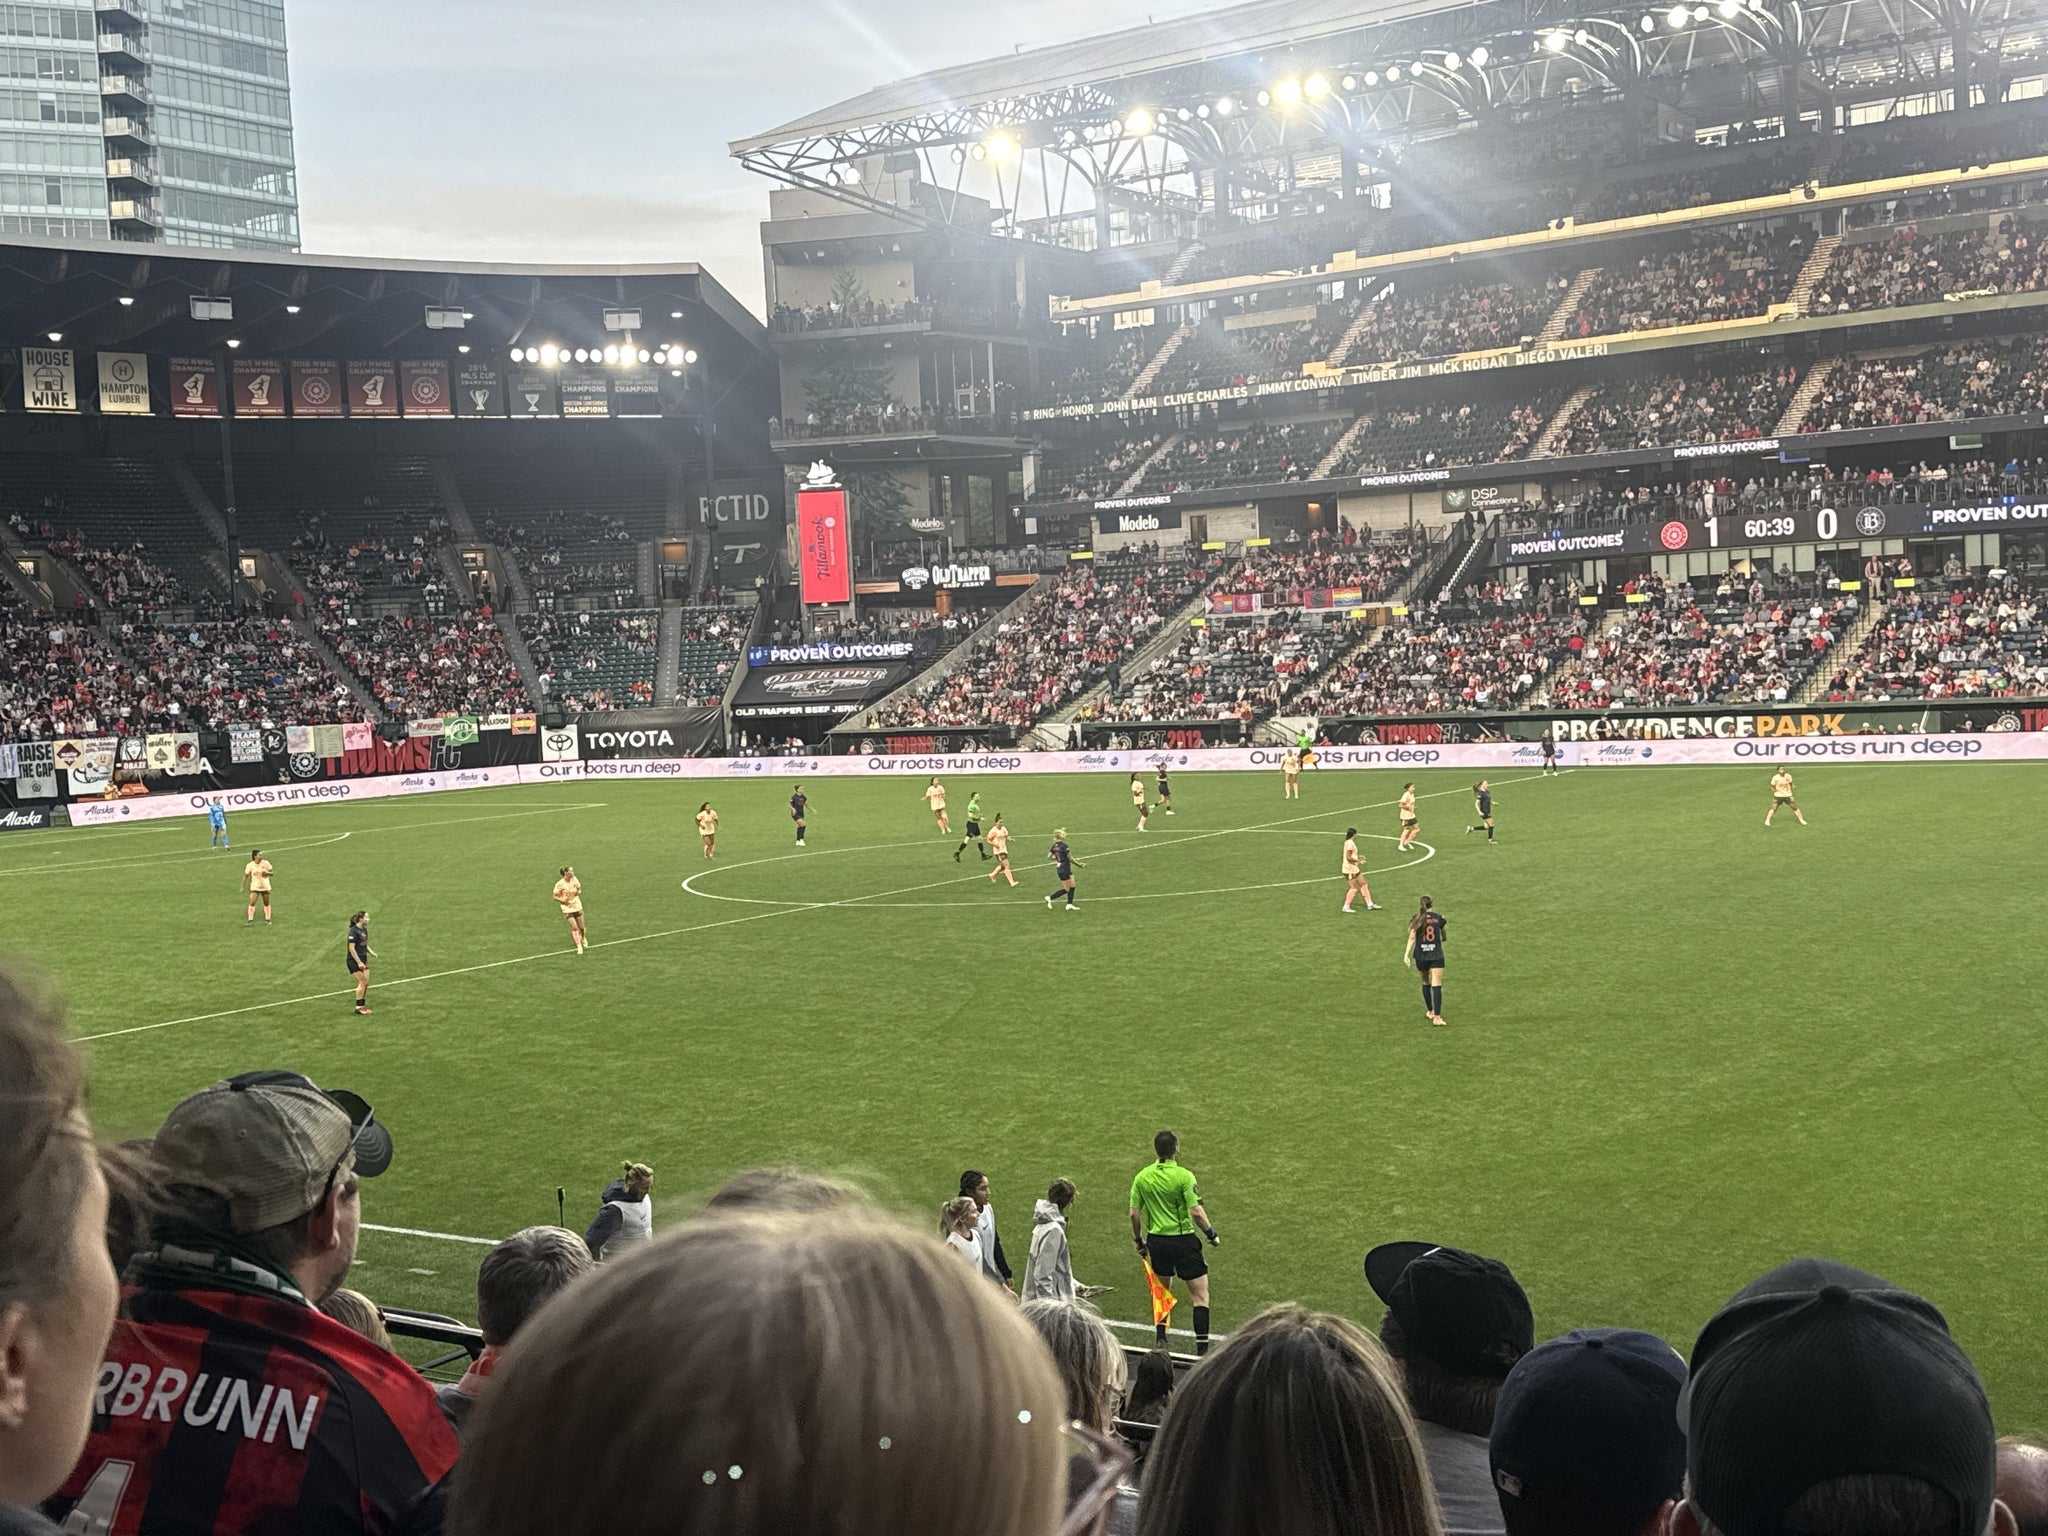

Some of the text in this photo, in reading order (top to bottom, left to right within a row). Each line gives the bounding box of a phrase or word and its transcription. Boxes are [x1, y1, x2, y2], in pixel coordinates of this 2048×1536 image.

[26, 351, 70, 367] HOUSE
[101, 383, 148, 394] HAMPTON
[1033, 408, 1055, 420] RING
[1062, 404, 1094, 418] HONOR
[1101, 400, 1129, 413] JOHN
[1131, 397, 1157, 409] BAIN
[1164, 394, 1195, 406] CLIVE
[1197, 387, 1248, 402] CHARLES
[1255, 381, 1292, 396] JIMMY
[1294, 375, 1343, 391] CONWAY
[1351, 369, 1397, 385] TIMBER
[1400, 364, 1421, 379] JIM
[1429, 361, 1460, 375] MICK
[1463, 355, 1507, 372] HOBAN
[1515, 351, 1555, 366] DIEGO
[1558, 345, 1608, 361] VALERI
[32, 391, 69, 407] WINE
[108, 394, 141, 404] LUMBER
[1674, 439, 1780, 458] PROVEN OUTCOMES
[1361, 470, 1450, 486] PROVEN OUTCOMES
[1471, 487, 1498, 500] DSP
[1094, 495, 1171, 509] PROVEN OUTCOMES
[1471, 496, 1518, 508] Connections
[1932, 506, 2008, 523] PROVEN
[911, 518, 941, 528] Modelo
[1118, 514, 1159, 532] Modelo
[1744, 517, 1795, 538] 60:39
[1816, 508, 1838, 540] 0
[1704, 517, 1719, 547] 1
[1511, 539, 1556, 555] PROVEN
[771, 643, 913, 662] PROVEN OUTCOMES
[766, 668, 887, 684] OLD TRAPPER
[735, 704, 864, 717] OLD TRAPPER BEEF JERKY
[231, 731, 260, 740] TRANS
[1552, 713, 1845, 742] PROVIDENCE PARK
[585, 730, 675, 750] TOYOTA
[1734, 738, 1982, 757] Our roots run deep
[17, 743, 52, 762] RAISE
[1077, 754, 1106, 764] Alaska
[1144, 752, 1174, 763] Alaska
[1348, 750, 1381, 764] run
[1385, 748, 1440, 765] deep
[1598, 745, 1635, 757] Alaska
[19, 762, 54, 779] THE CAP
[539, 761, 681, 777] Our roots run deep
[868, 756, 1021, 770] Our roots run deep
[401, 777, 424, 786] Alaska
[190, 784, 350, 808] Ou roots run deep
[0, 810, 42, 826] Alaska
[84, 805, 115, 815] Alaska
